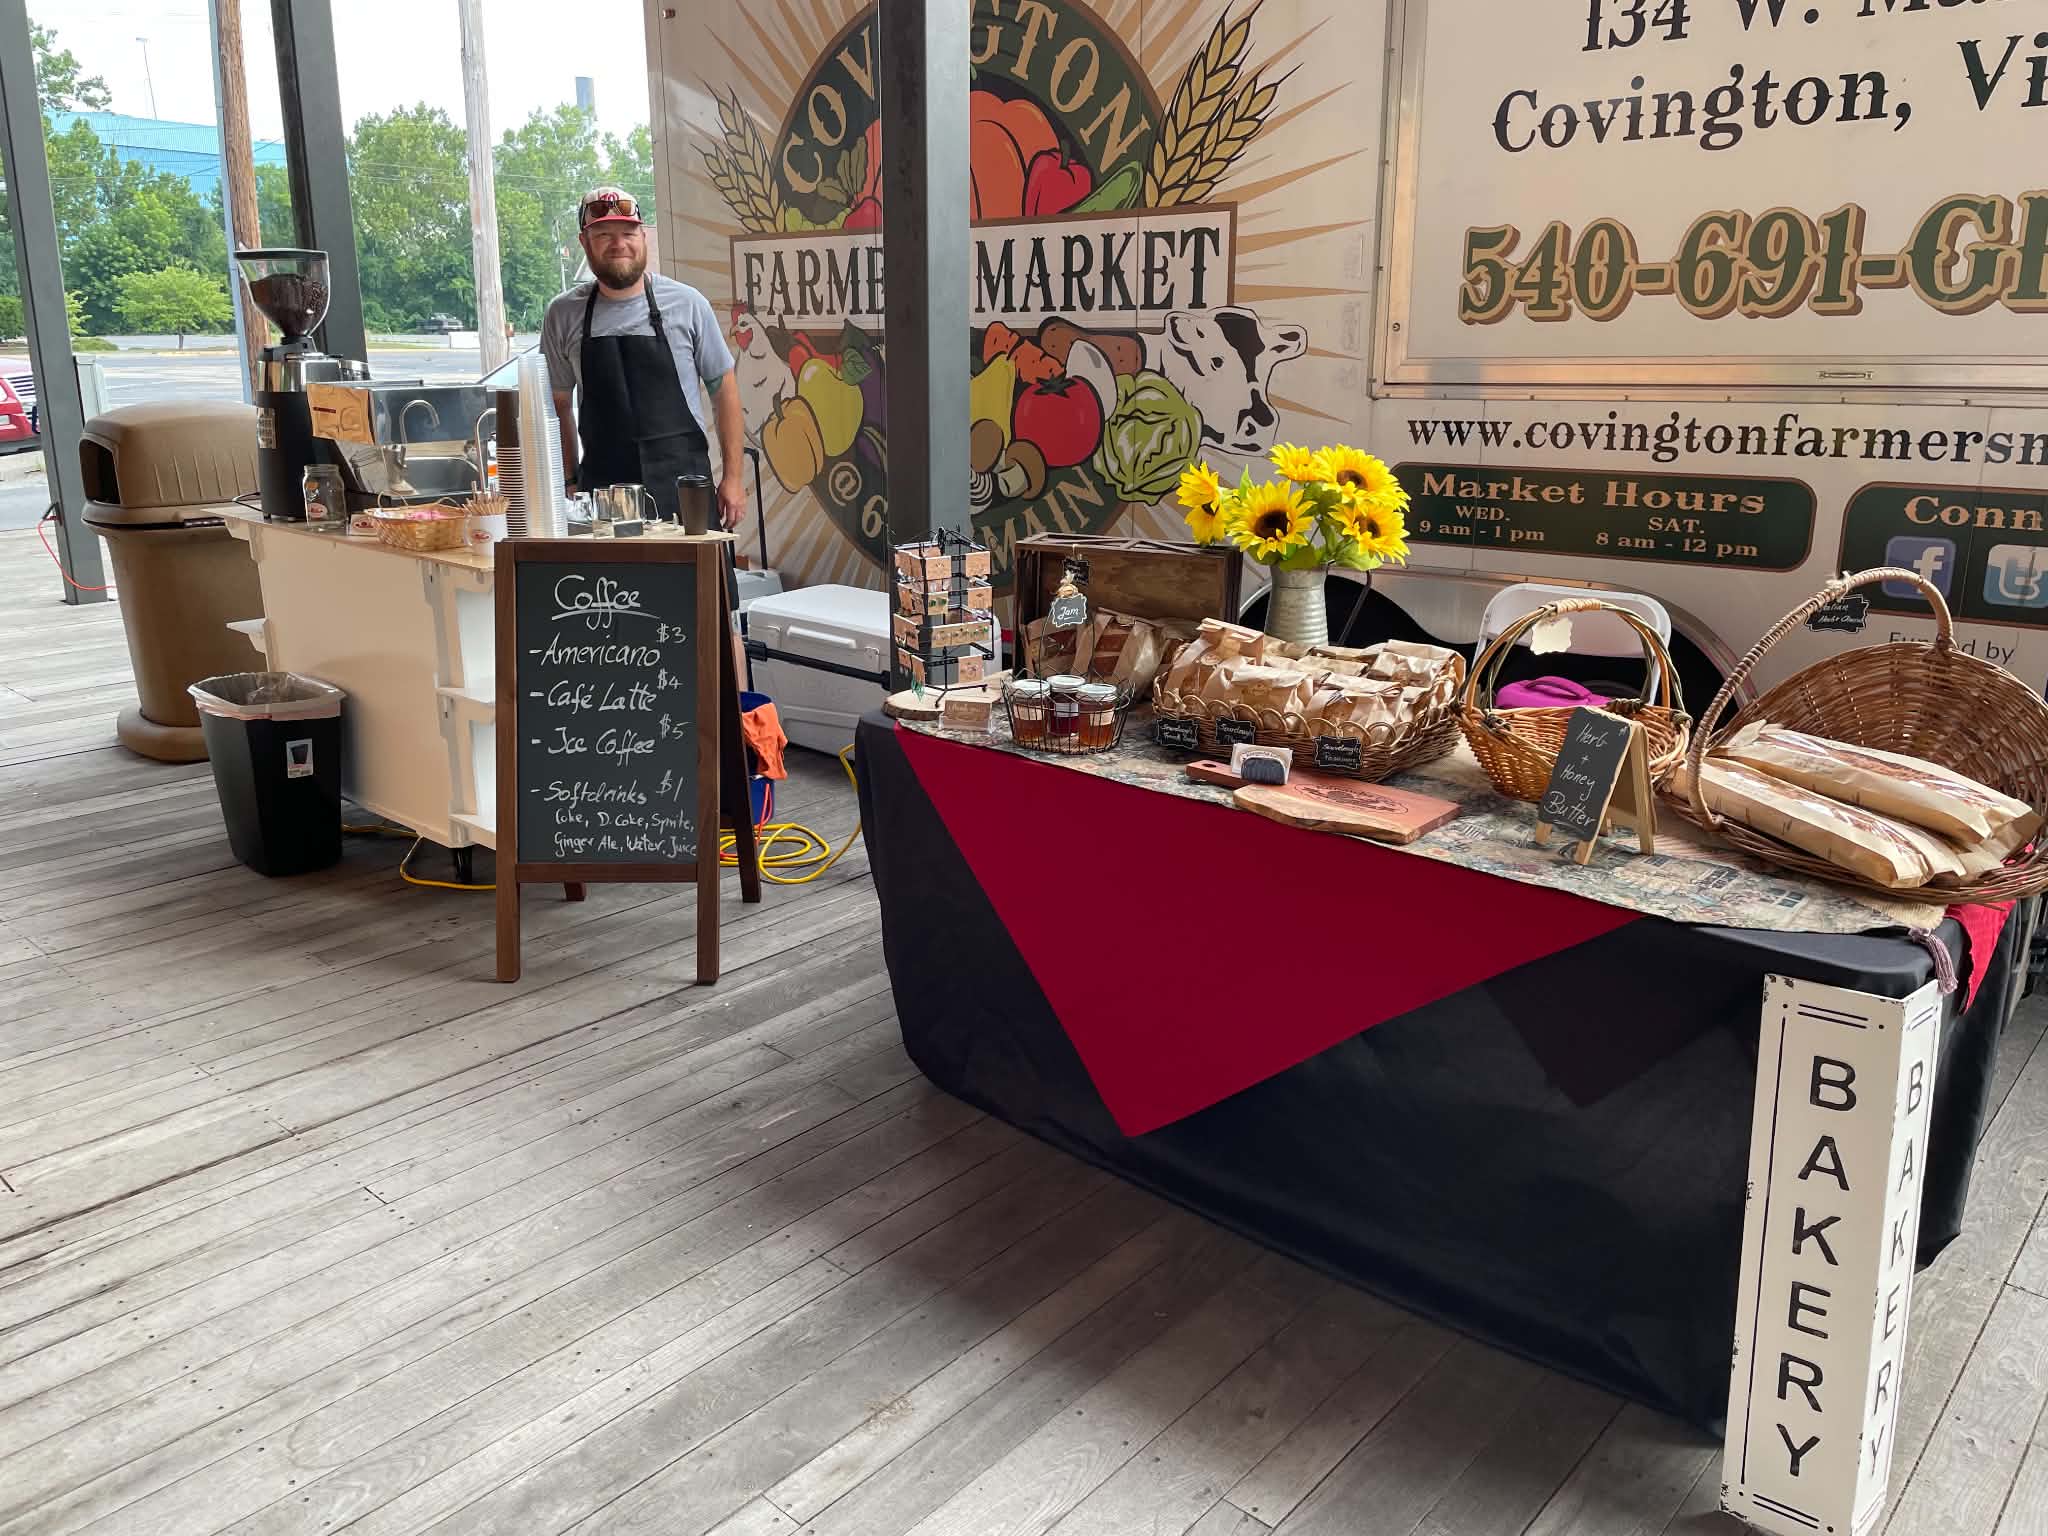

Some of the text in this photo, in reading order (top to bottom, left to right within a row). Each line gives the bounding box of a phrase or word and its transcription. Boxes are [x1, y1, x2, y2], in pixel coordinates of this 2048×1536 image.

[1582, 0, 1691, 52] 134
[782, 0, 1151, 193] COVGTON
[1492, 63, 1912, 152] Covington,
[744, 227, 1221, 316] FARME MARKET
[1420, 472, 1766, 515] Market Hours
[1418, 519, 1432, 535] 9
[1438, 523, 1472, 536] am
[1494, 525, 1502, 538] 1
[1510, 527, 1545, 542] pm
[1455, 505, 1511, 522] WED.
[1647, 516, 1705, 535] SAT.
[1595, 532, 1609, 545] 8
[1617, 536, 1656, 549] am
[1682, 537, 1707, 553] 12
[1716, 542, 1760, 558] pm
[554, 574, 641, 631] Coffee
[1057, 606, 1079, 620] Jam
[656, 623, 688, 644] $3
[1986, 640, 2015, 665] by
[598, 681, 658, 712] Latte
[657, 668, 684, 691] $4
[547, 726, 588, 755] Ice
[595, 728, 656, 767] Coffee
[659, 713, 691, 740] $5
[1575, 722, 1609, 748] Herb
[543, 779, 648, 810] Softdrinks
[655, 769, 684, 803] $1
[1560, 763, 1596, 801] Honey
[555, 808, 589, 828] Coke,
[614, 813, 649, 830] Coke,
[1543, 790, 1598, 827] Butter
[554, 831, 595, 857] Ginger
[597, 835, 624, 853] Ale,
[666, 836, 697, 859] Juice
[1776, 1055, 1857, 1477] BAKERY
[1866, 1060, 1923, 1476] BAKERY
